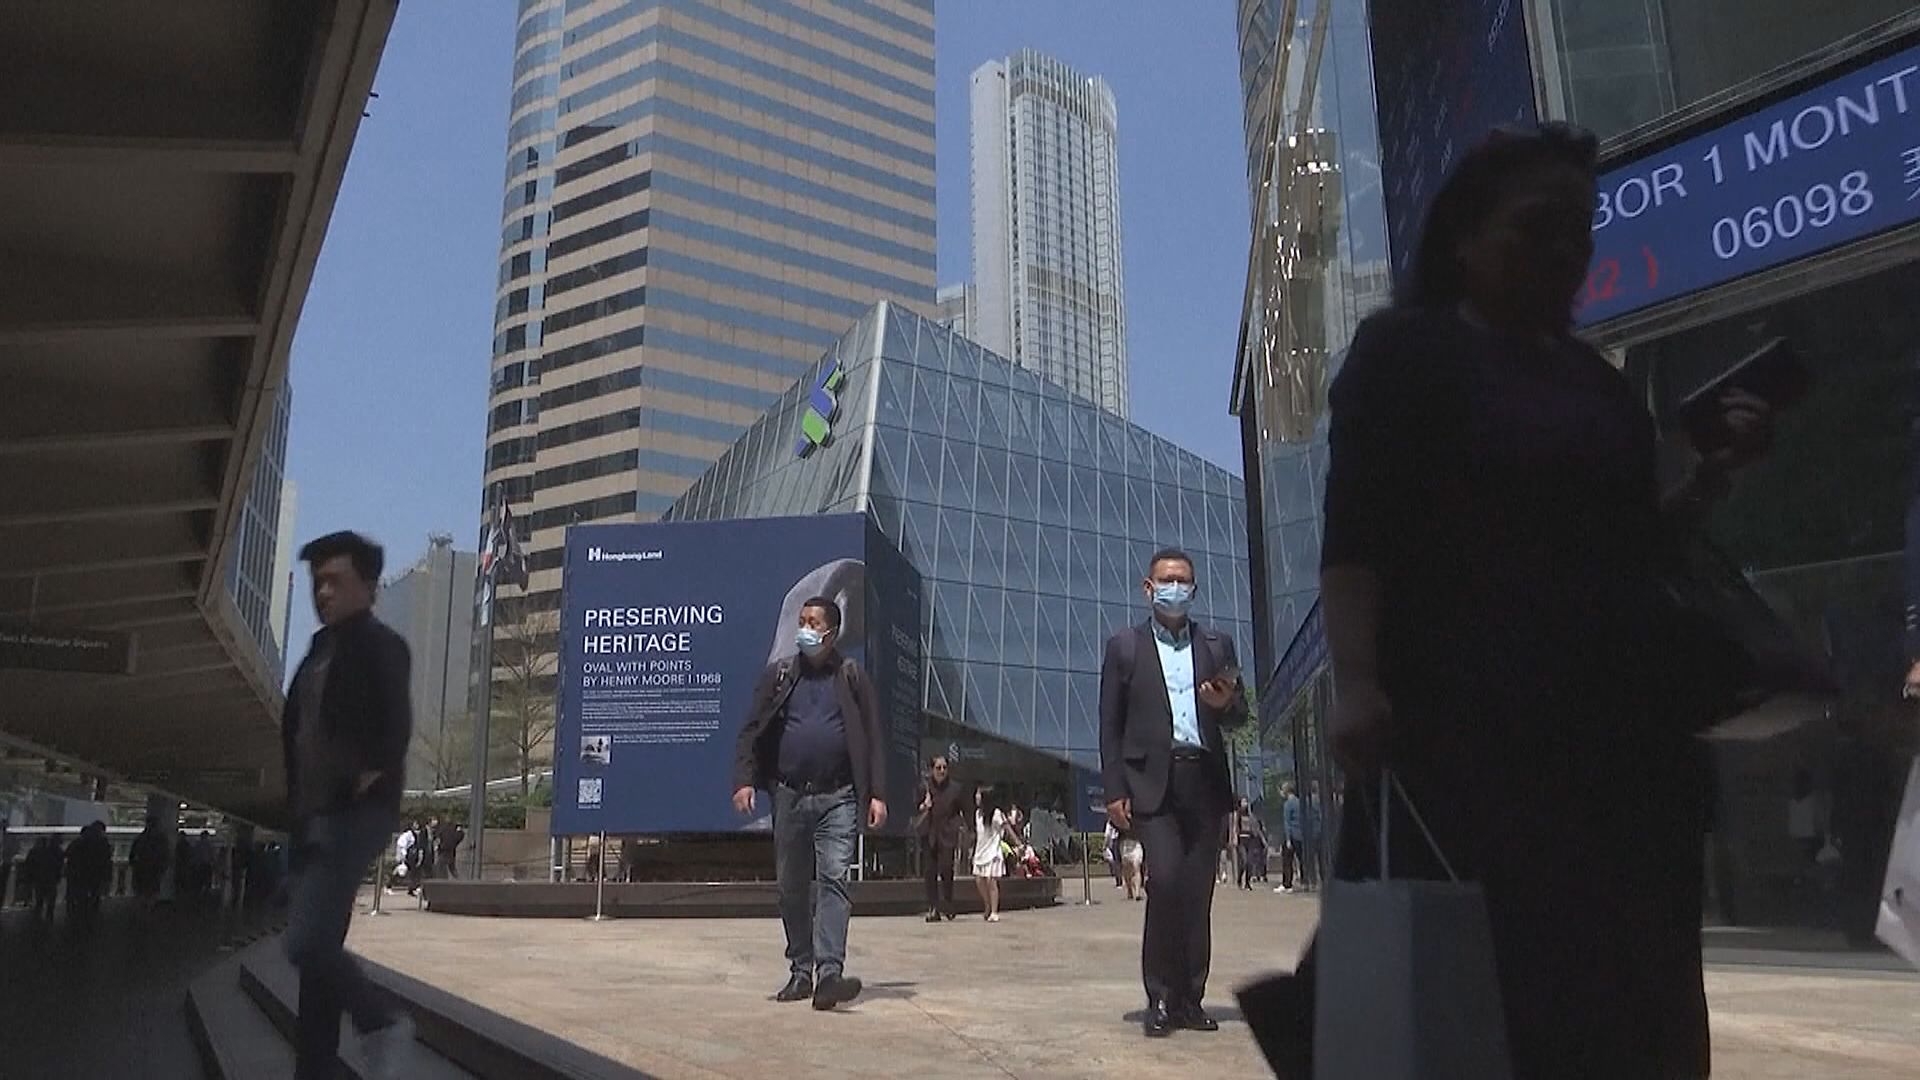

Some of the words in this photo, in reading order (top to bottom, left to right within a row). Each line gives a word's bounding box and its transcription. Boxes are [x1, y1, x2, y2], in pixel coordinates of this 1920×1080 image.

[1703, 144, 1724, 185] 1
[1712, 170, 1874, 260] 06098
[584, 605, 723, 628] PRESERVING
[583, 632, 691, 654] HERITAGE
[582, 661, 613, 673] OVAL
[616, 660, 647, 672] WITH
[650, 659, 692, 671] POINTS
[582, 675, 598, 687] BY
[600, 674, 639, 687] HENRY
[641, 673, 685, 686] MOORE
[695, 673, 722, 684] 1968
